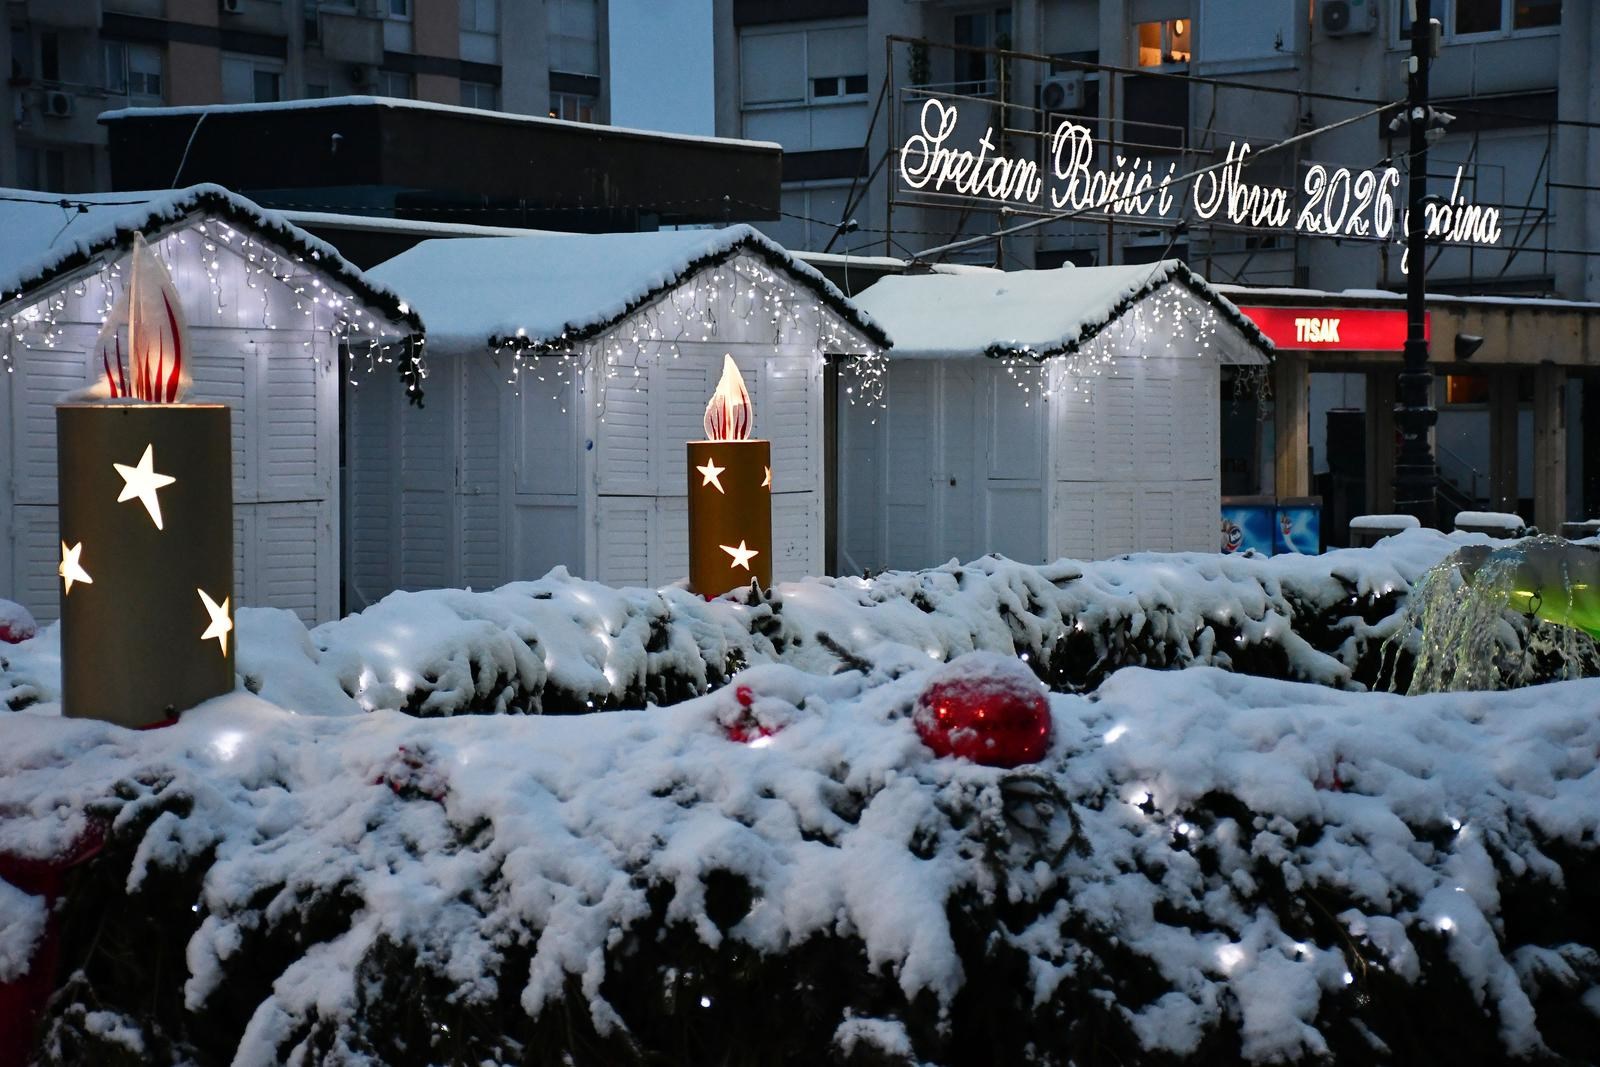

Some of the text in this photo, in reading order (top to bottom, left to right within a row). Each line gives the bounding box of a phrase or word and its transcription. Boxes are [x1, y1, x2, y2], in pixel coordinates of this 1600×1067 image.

[900, 98, 1041, 203] Sretan
[1051, 120, 1154, 215] Božić
[1158, 162, 1176, 216] i
[1193, 140, 1291, 228] Nova
[1294, 317, 1341, 343] TISAK
